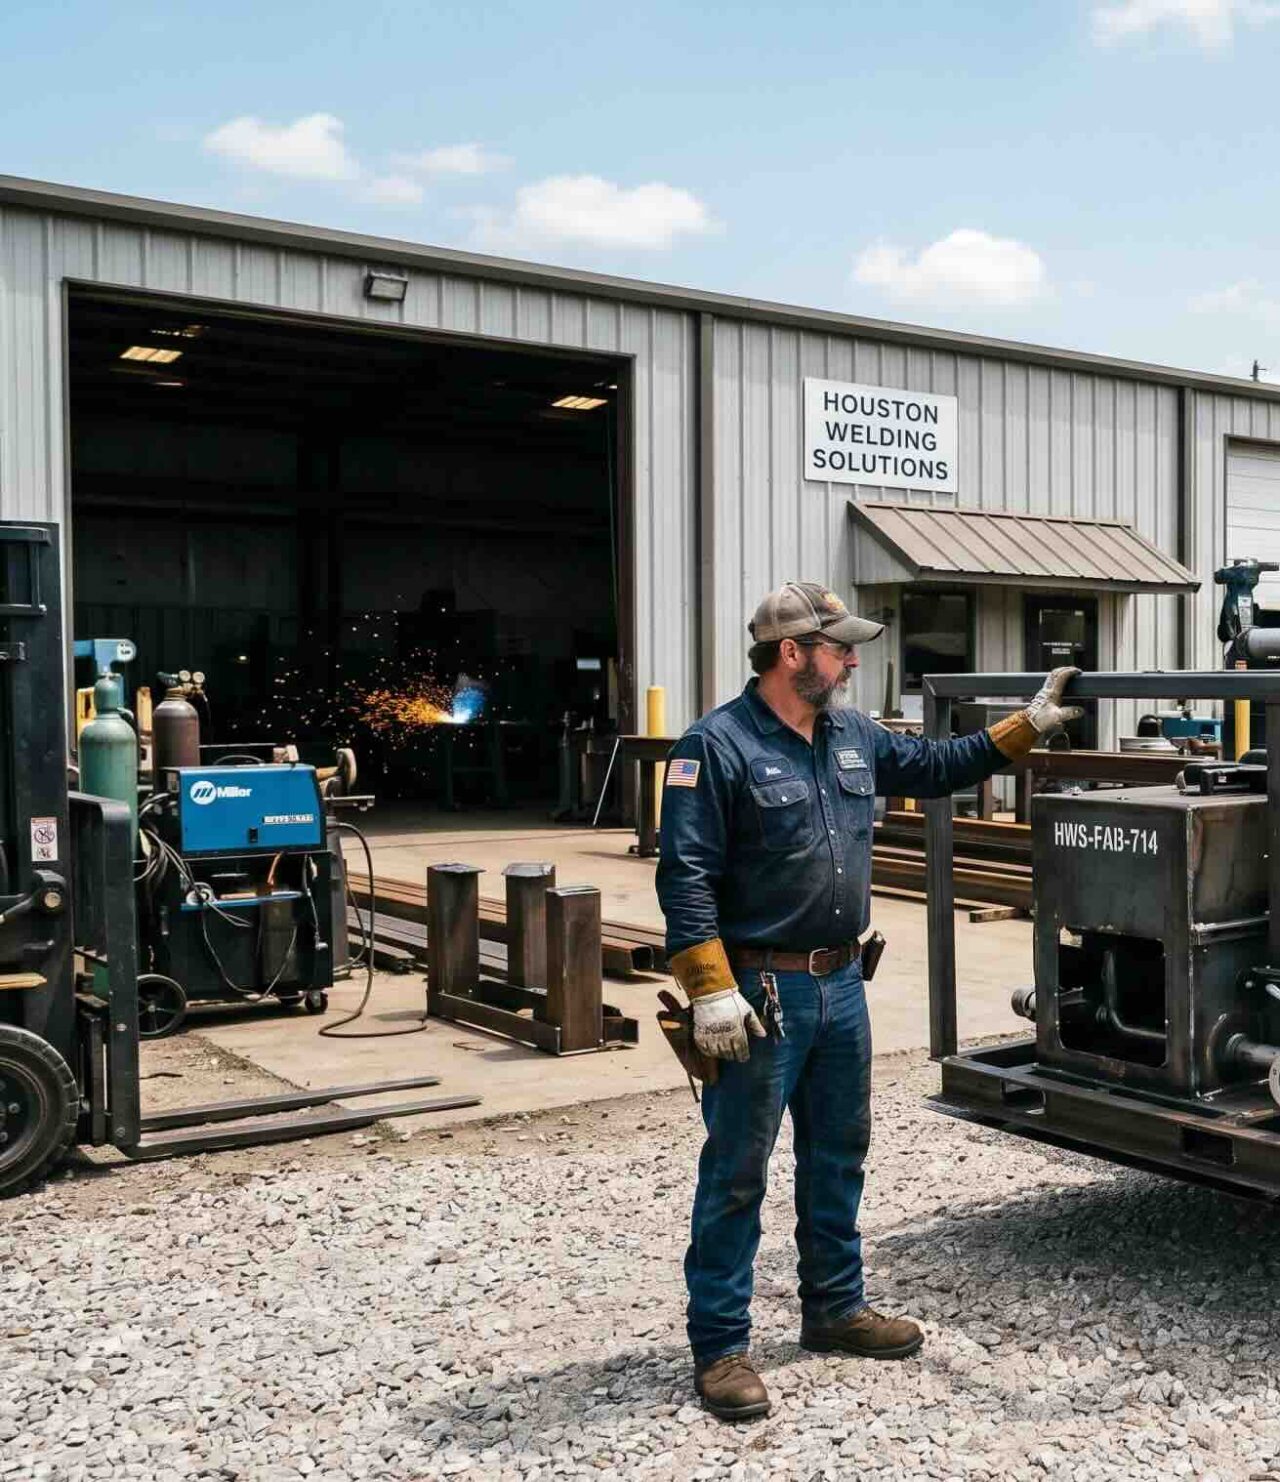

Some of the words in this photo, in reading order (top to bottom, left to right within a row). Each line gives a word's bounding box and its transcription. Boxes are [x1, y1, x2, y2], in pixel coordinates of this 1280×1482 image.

[824, 391, 938, 424] HOUSTON
[825, 421, 937, 451] WELDING
[813, 448, 948, 480] SOLUTIONS
[1054, 821, 1158, 855] HWS-FAB-714
